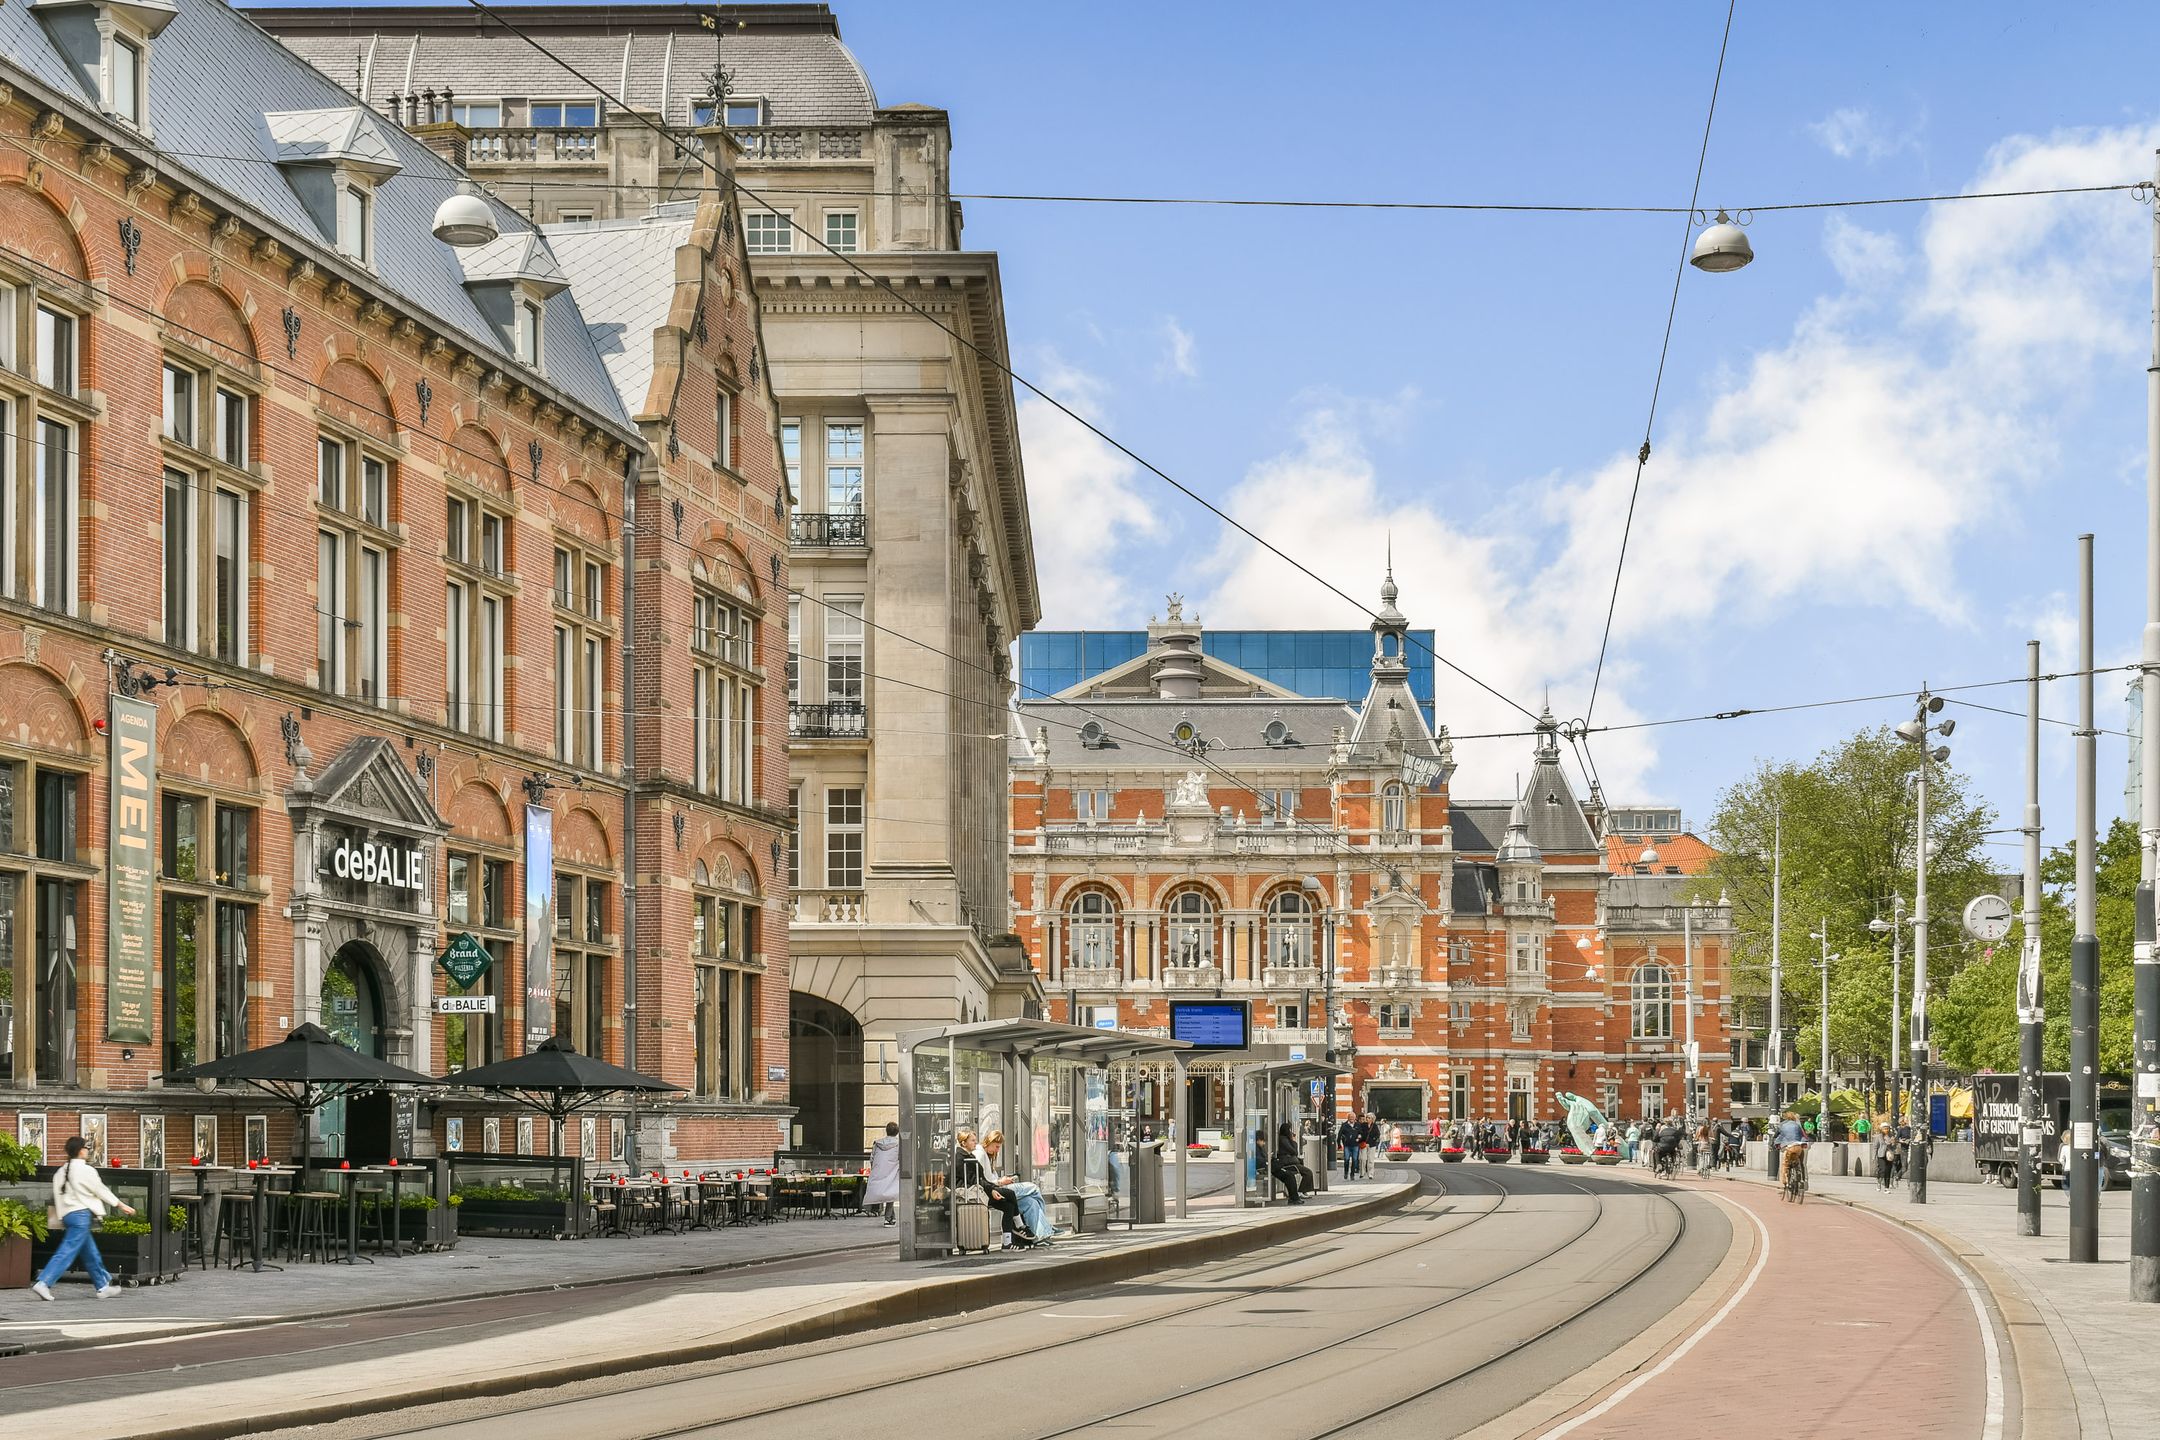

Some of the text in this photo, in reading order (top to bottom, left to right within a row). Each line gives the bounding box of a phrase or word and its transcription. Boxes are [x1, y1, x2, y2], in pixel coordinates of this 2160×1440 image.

[120, 713, 148, 729] AGENDA
[119, 736, 148, 850] MEI
[334, 838, 423, 890] deBALIE
[449, 948, 479, 959] Brand
[442, 999, 487, 1011] dBALIE
[1982, 1103, 2020, 1117] A TRUCKLO
[1979, 1119, 1990, 1134] OF
